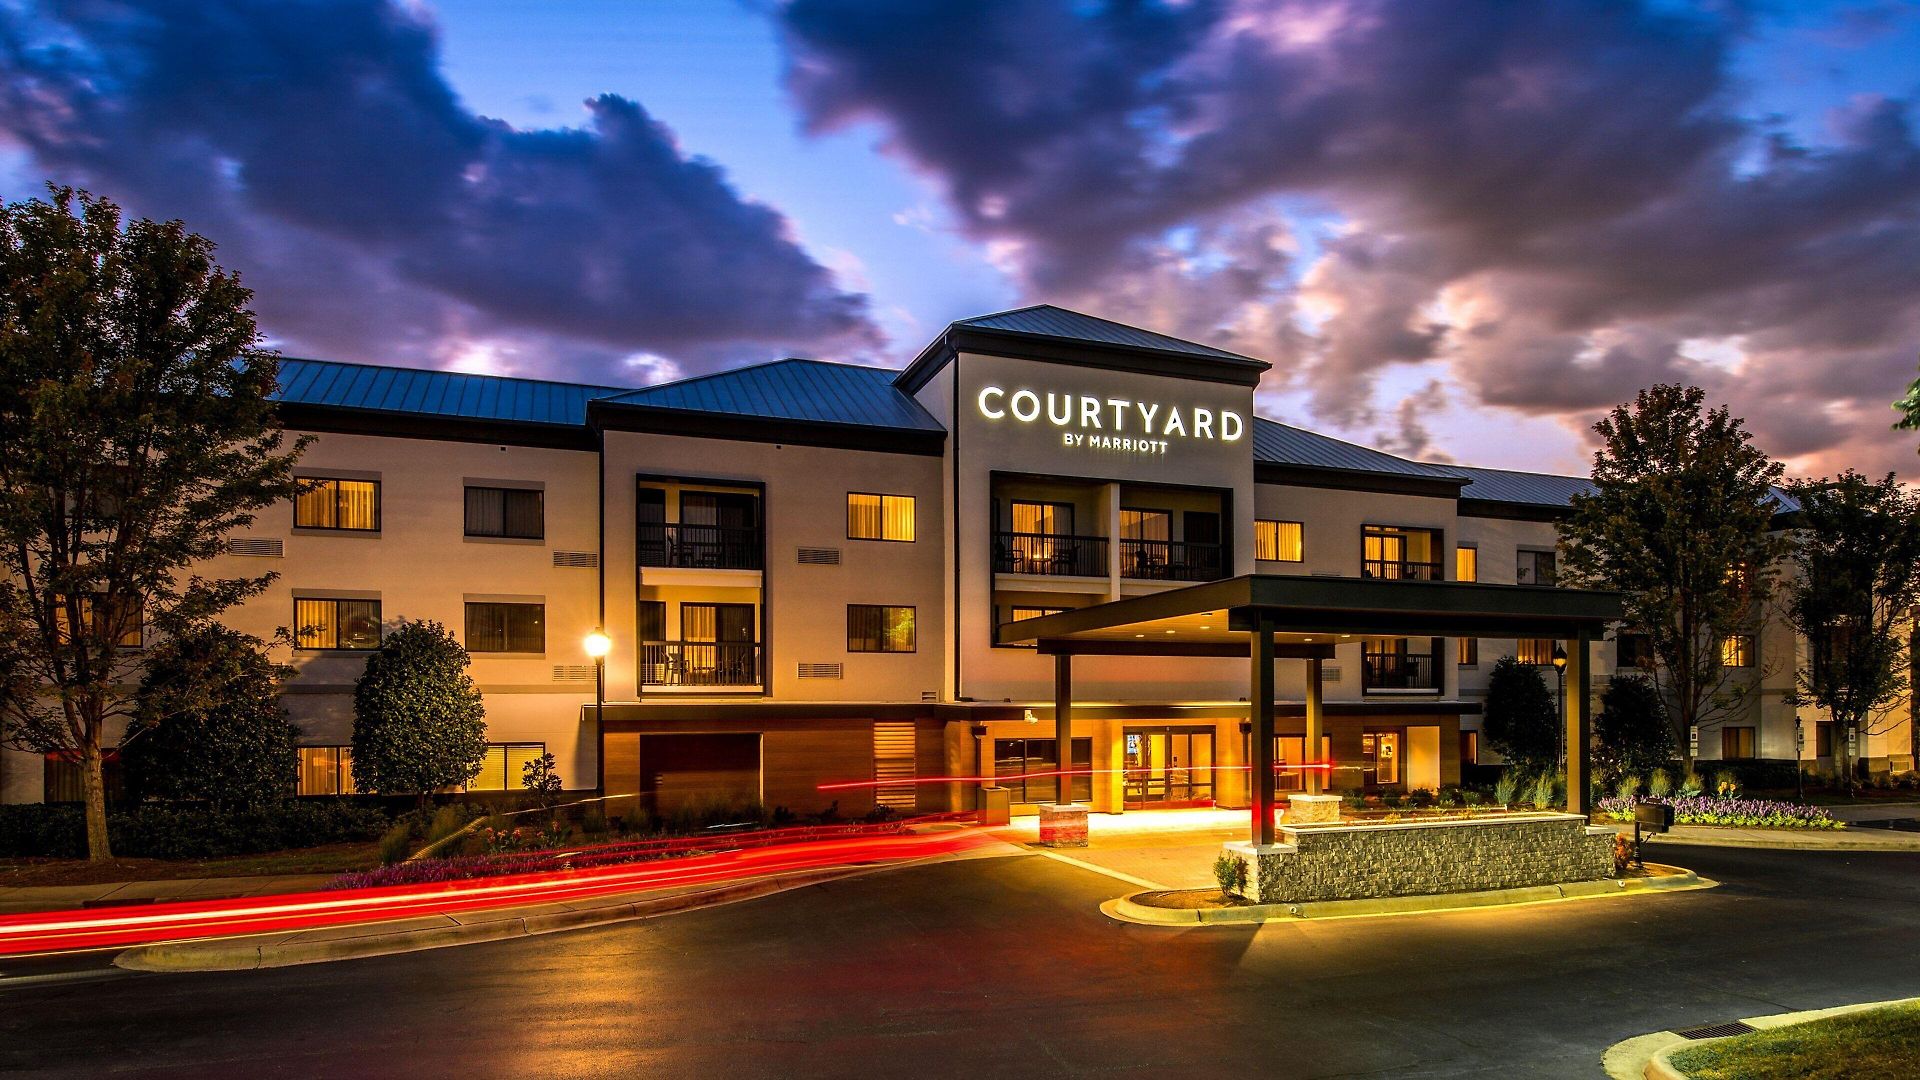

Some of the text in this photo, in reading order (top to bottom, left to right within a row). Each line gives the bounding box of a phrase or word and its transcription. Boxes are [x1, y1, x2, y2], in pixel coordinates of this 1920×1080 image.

[978, 386, 1243, 441] COURTYARD
[1064, 433, 1168, 453] BY MARRIOTT
